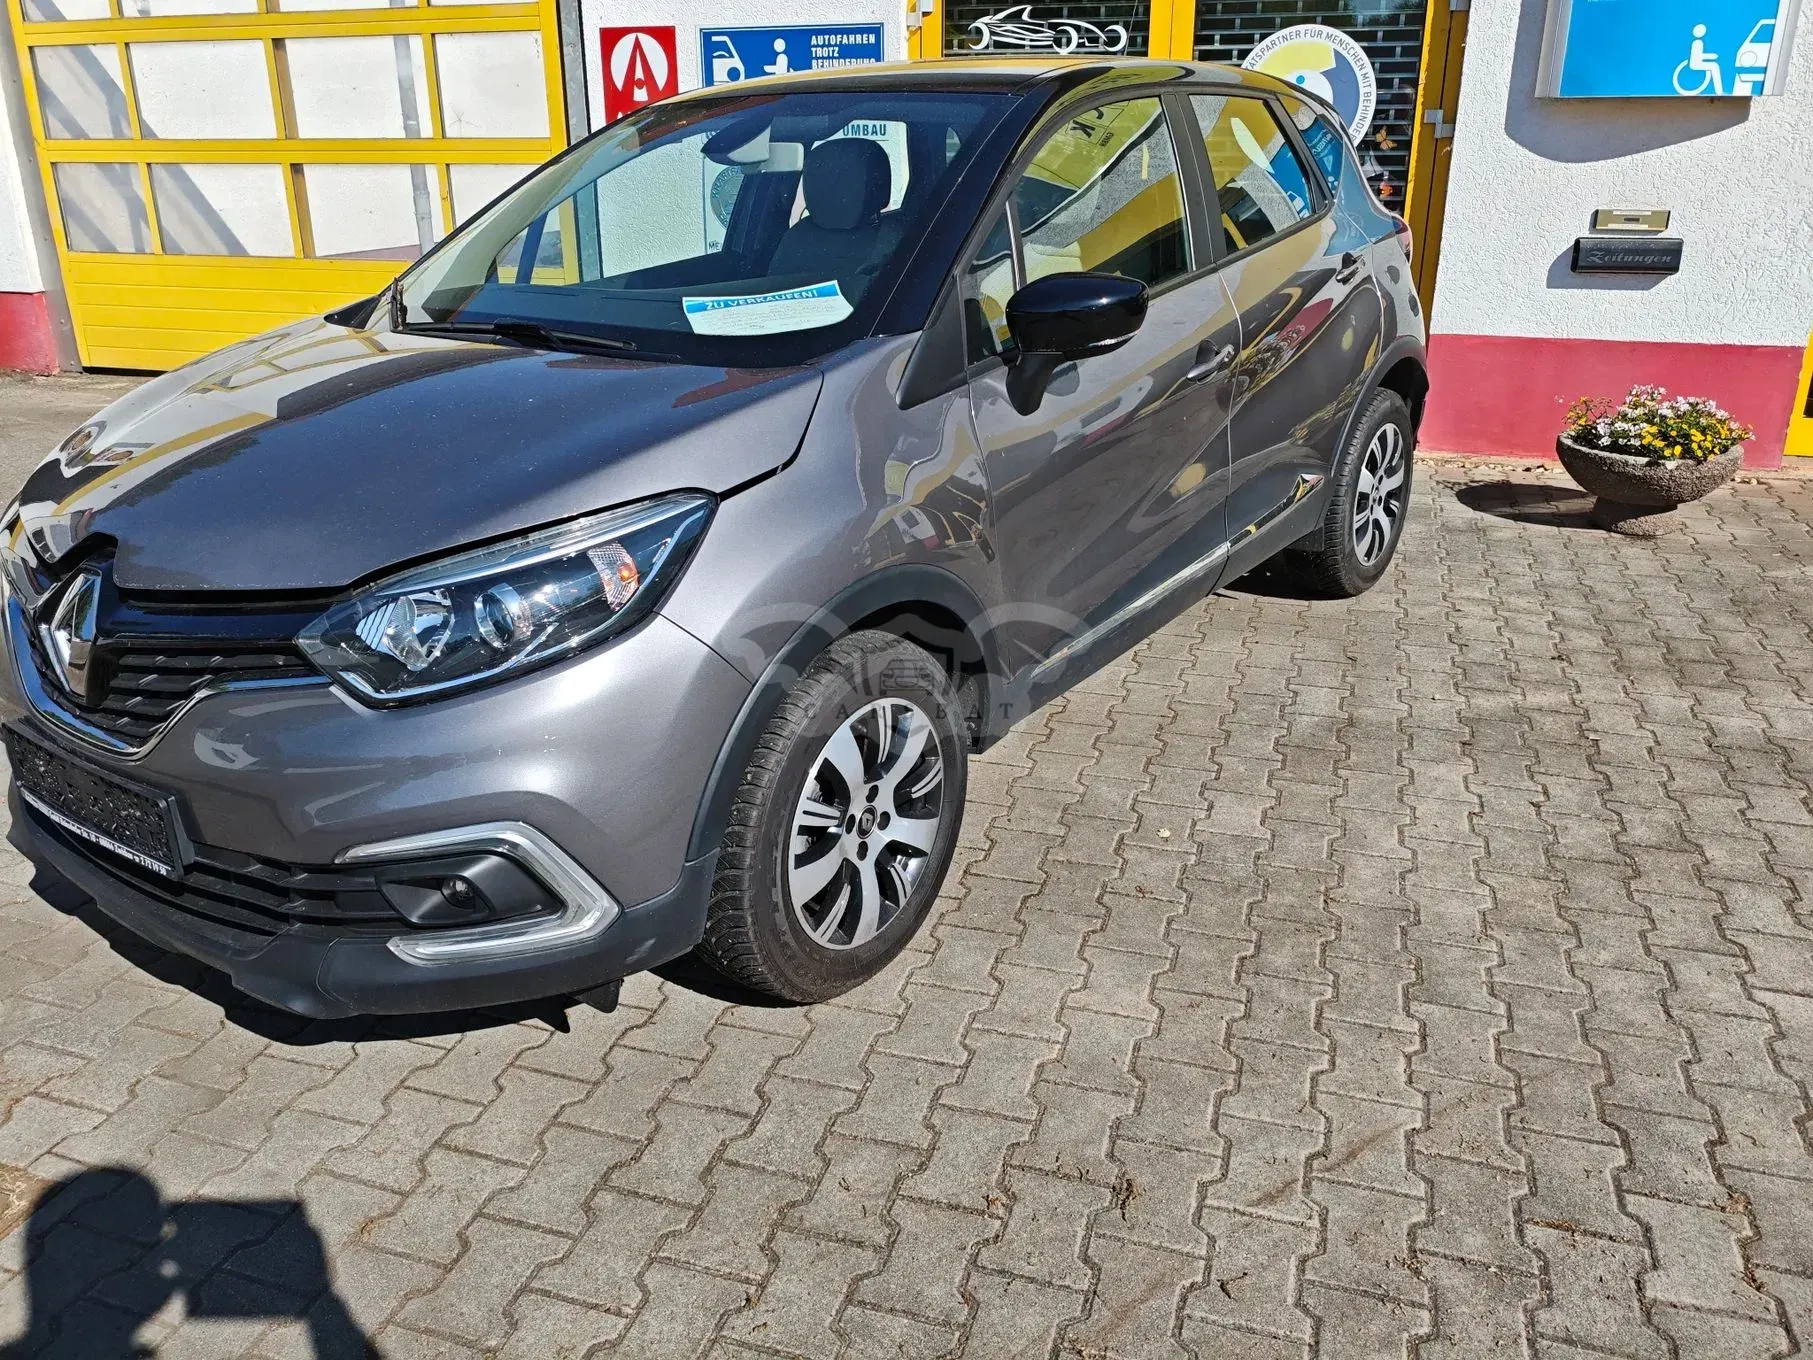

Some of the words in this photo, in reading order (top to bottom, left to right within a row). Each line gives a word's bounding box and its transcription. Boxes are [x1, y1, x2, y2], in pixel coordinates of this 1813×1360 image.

[811, 33, 876, 46] AUTOFAHREN
[811, 46, 839, 58] TROTZ
[1246, 30, 1302, 69] ÄTSPARTNER
[1303, 27, 1324, 39] FÜR
[1324, 32, 1367, 72] MENSCHEN
[1360, 72, 1372, 89] MIT
[1586, 250, 1673, 265] Zeitungen
[705, 301, 725, 311] ZU
